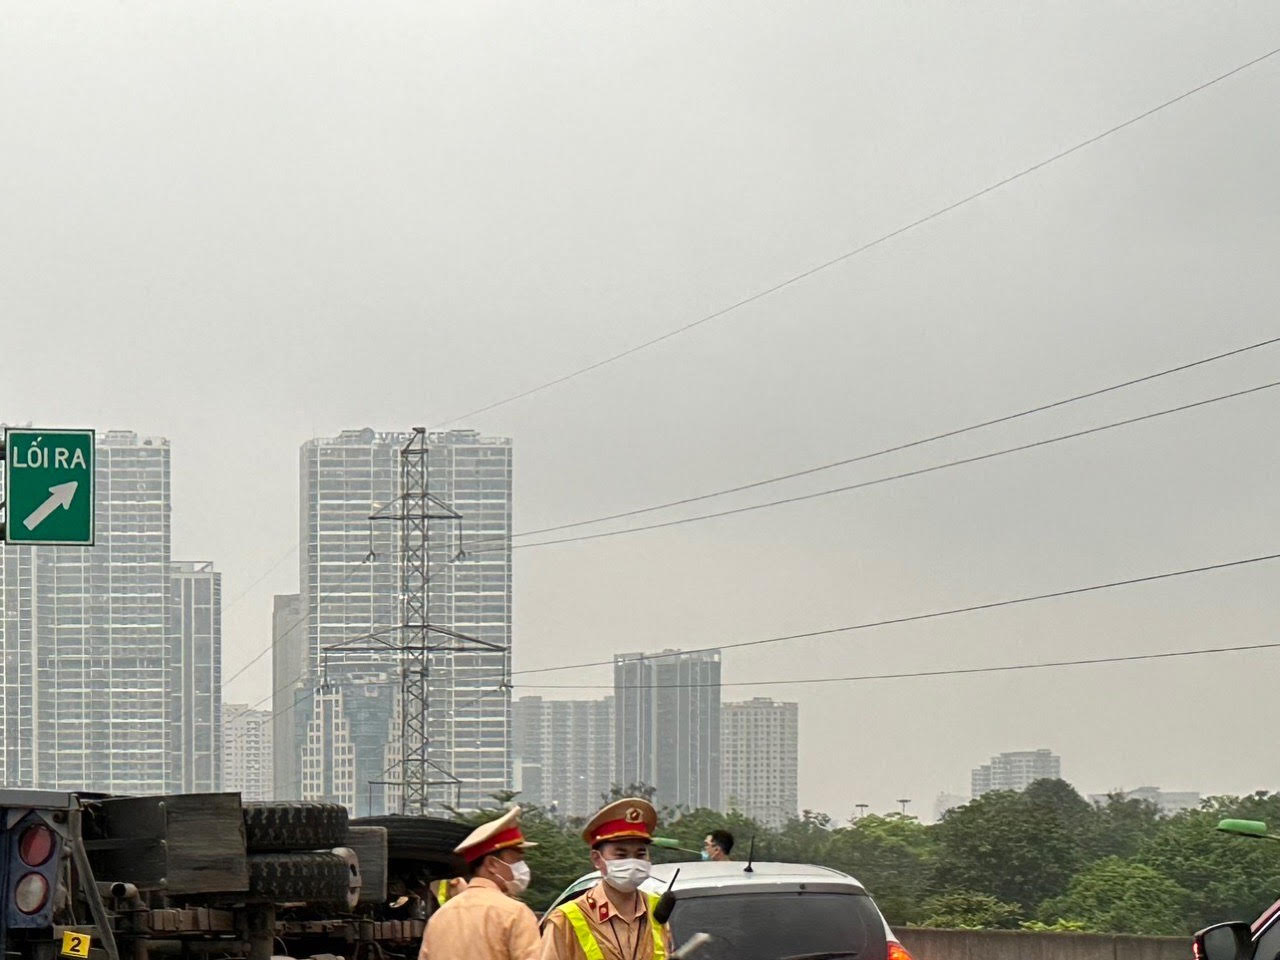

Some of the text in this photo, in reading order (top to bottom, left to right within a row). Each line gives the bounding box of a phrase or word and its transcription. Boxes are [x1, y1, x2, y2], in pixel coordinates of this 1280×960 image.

[12, 436, 87, 470] LỐI RA
[69, 936, 82, 953] 2
